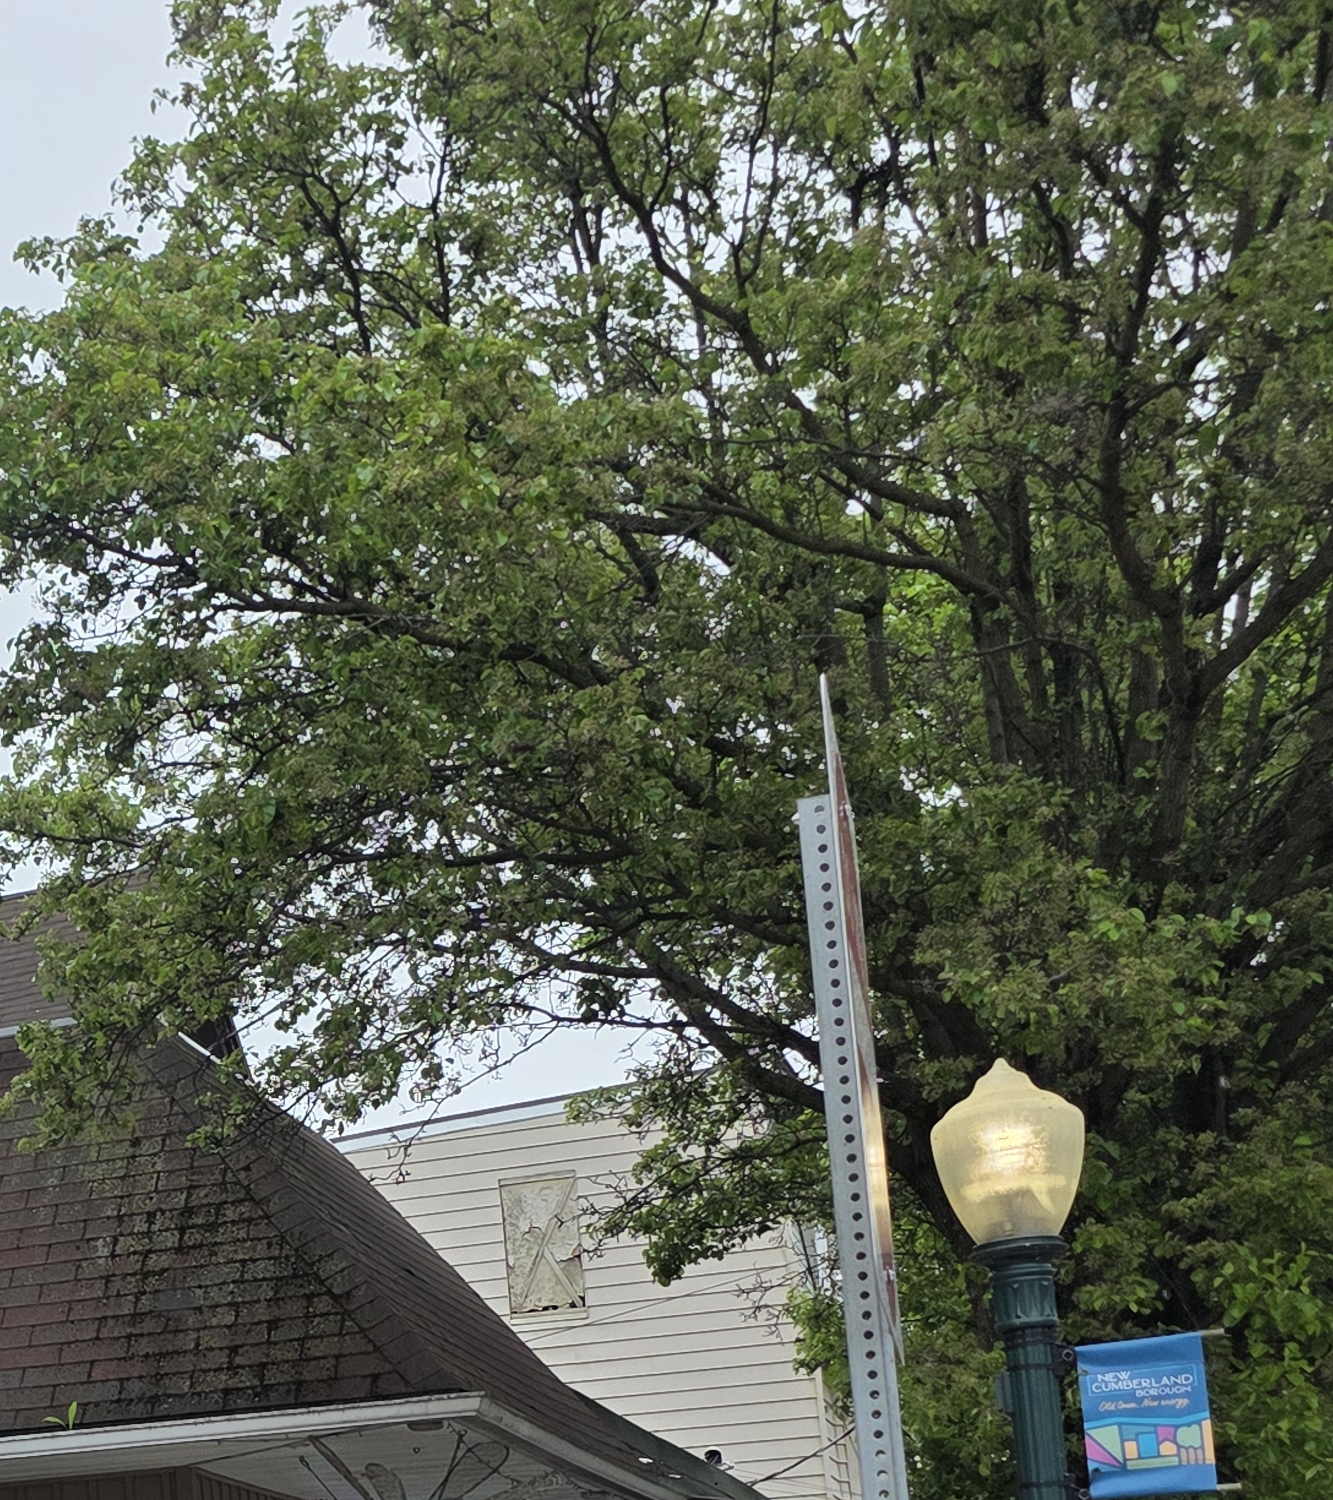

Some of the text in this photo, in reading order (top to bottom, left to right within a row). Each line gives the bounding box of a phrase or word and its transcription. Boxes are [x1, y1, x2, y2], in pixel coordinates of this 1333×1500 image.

[1096, 1370, 1131, 1382] NEW
[1092, 1373, 1193, 1392] CUMBERLAND
[1135, 1385, 1192, 1397] BOROUGH
